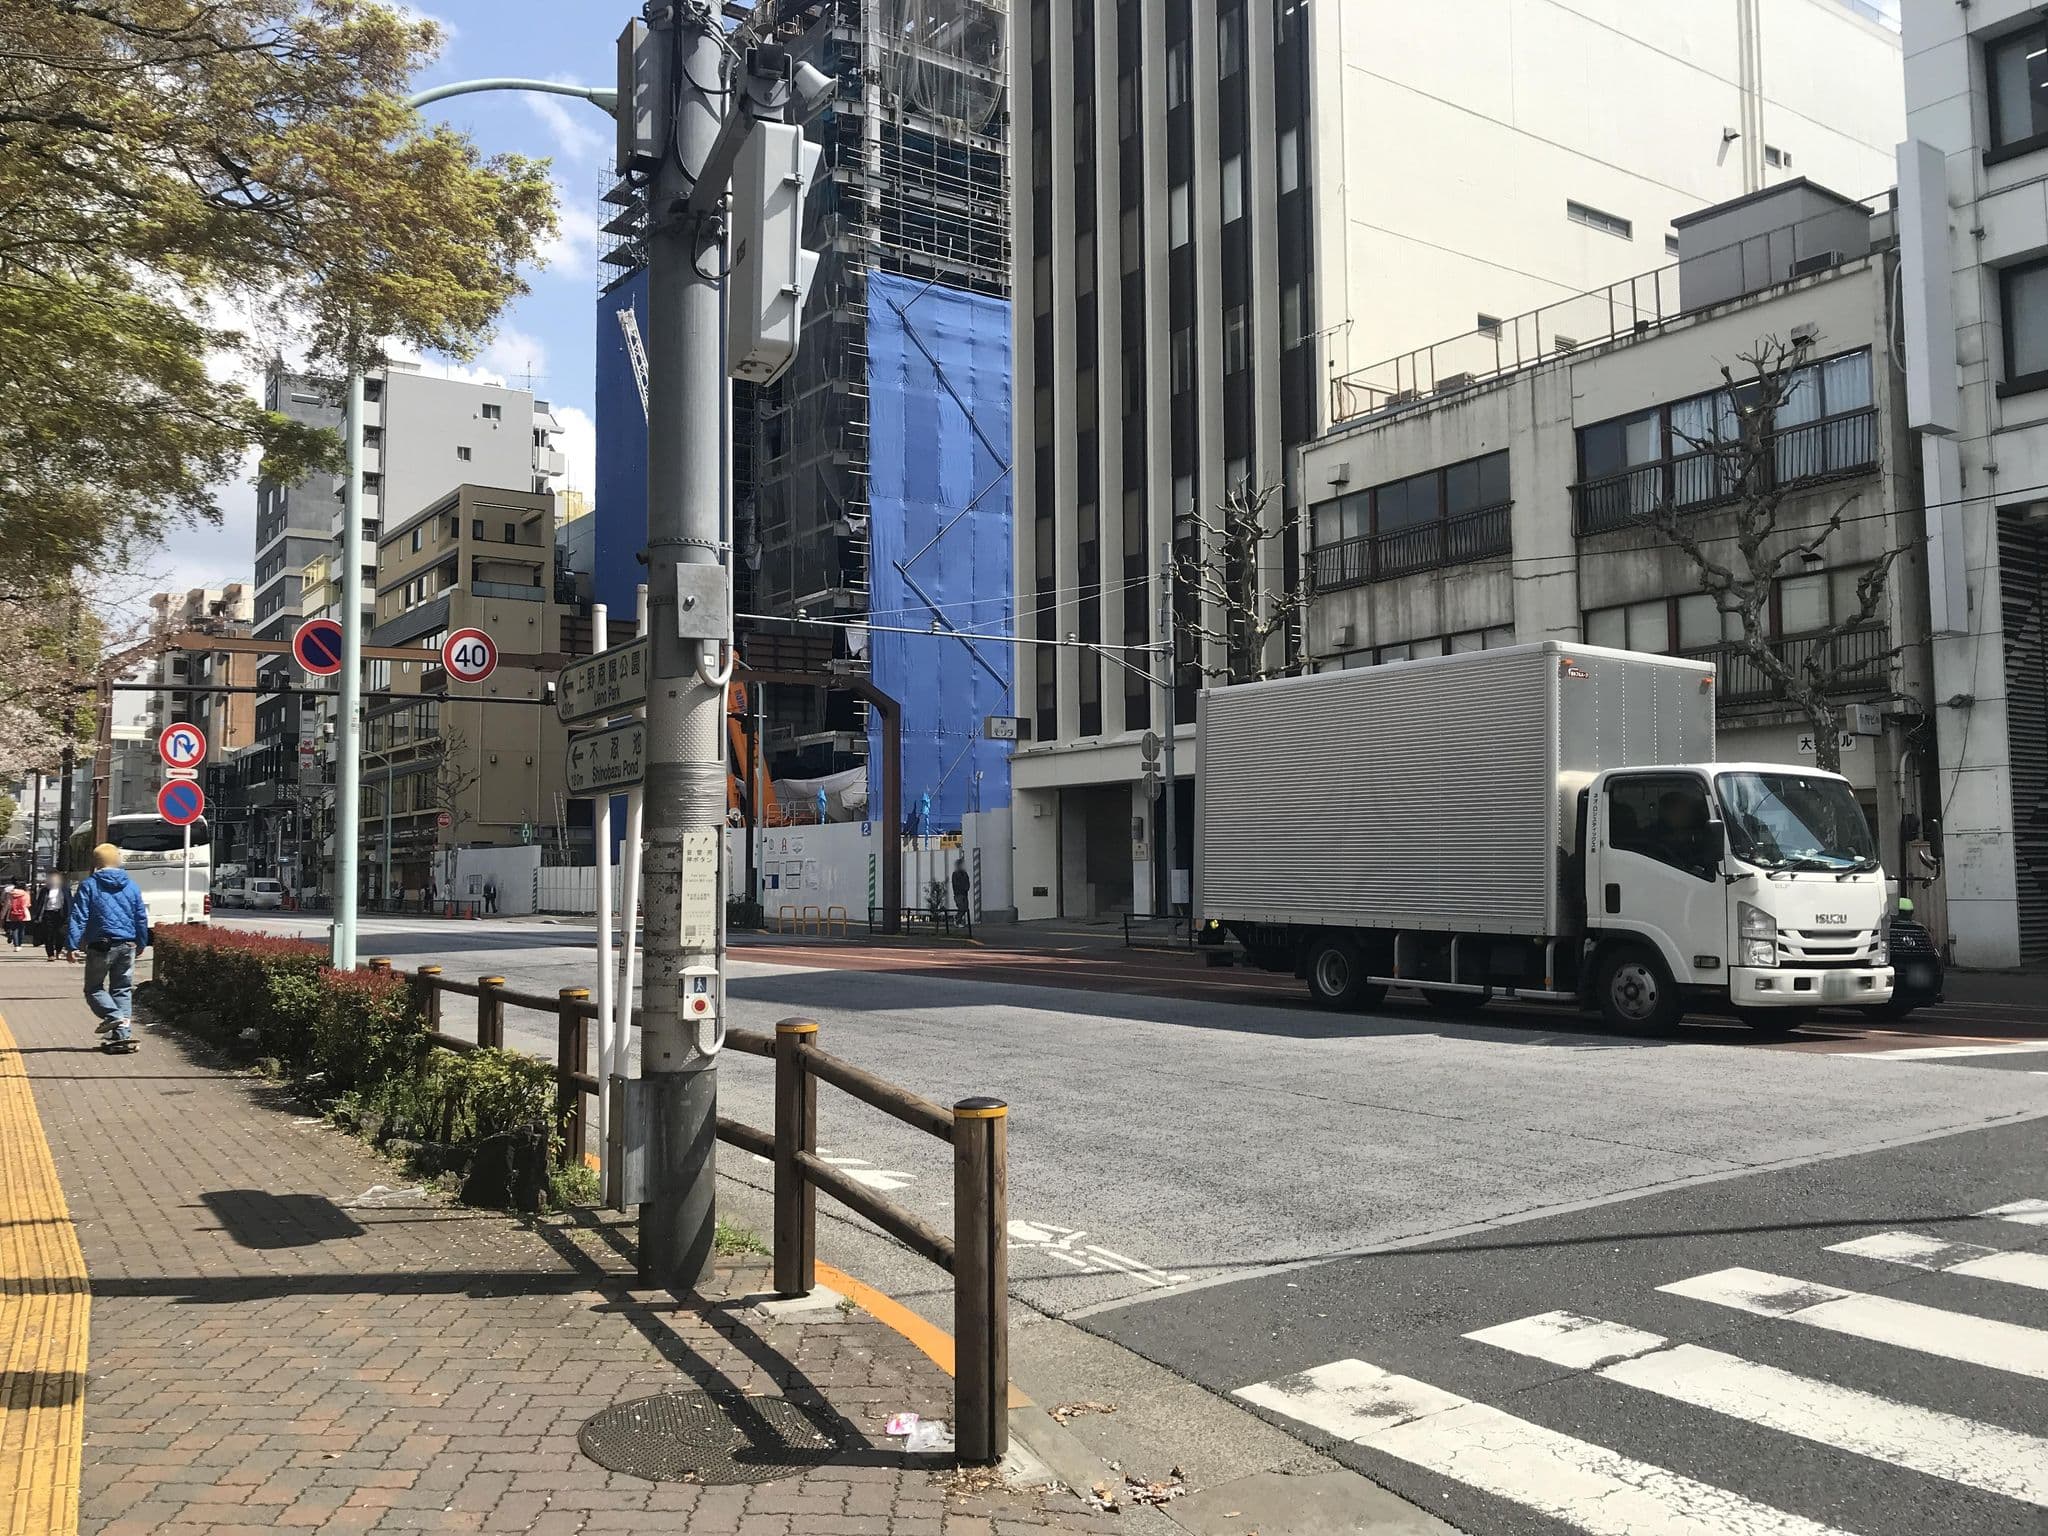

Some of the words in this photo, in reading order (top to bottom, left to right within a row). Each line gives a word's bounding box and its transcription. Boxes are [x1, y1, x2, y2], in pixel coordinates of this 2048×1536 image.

[455, 644, 486, 667] 40
[576, 650, 641, 695] 上野恩賜公園
[590, 730, 642, 760] 不忍池
[592, 763, 622, 785] Shinobazu
[623, 757, 639, 778] Pond
[1816, 913, 1847, 924] ISUZU
